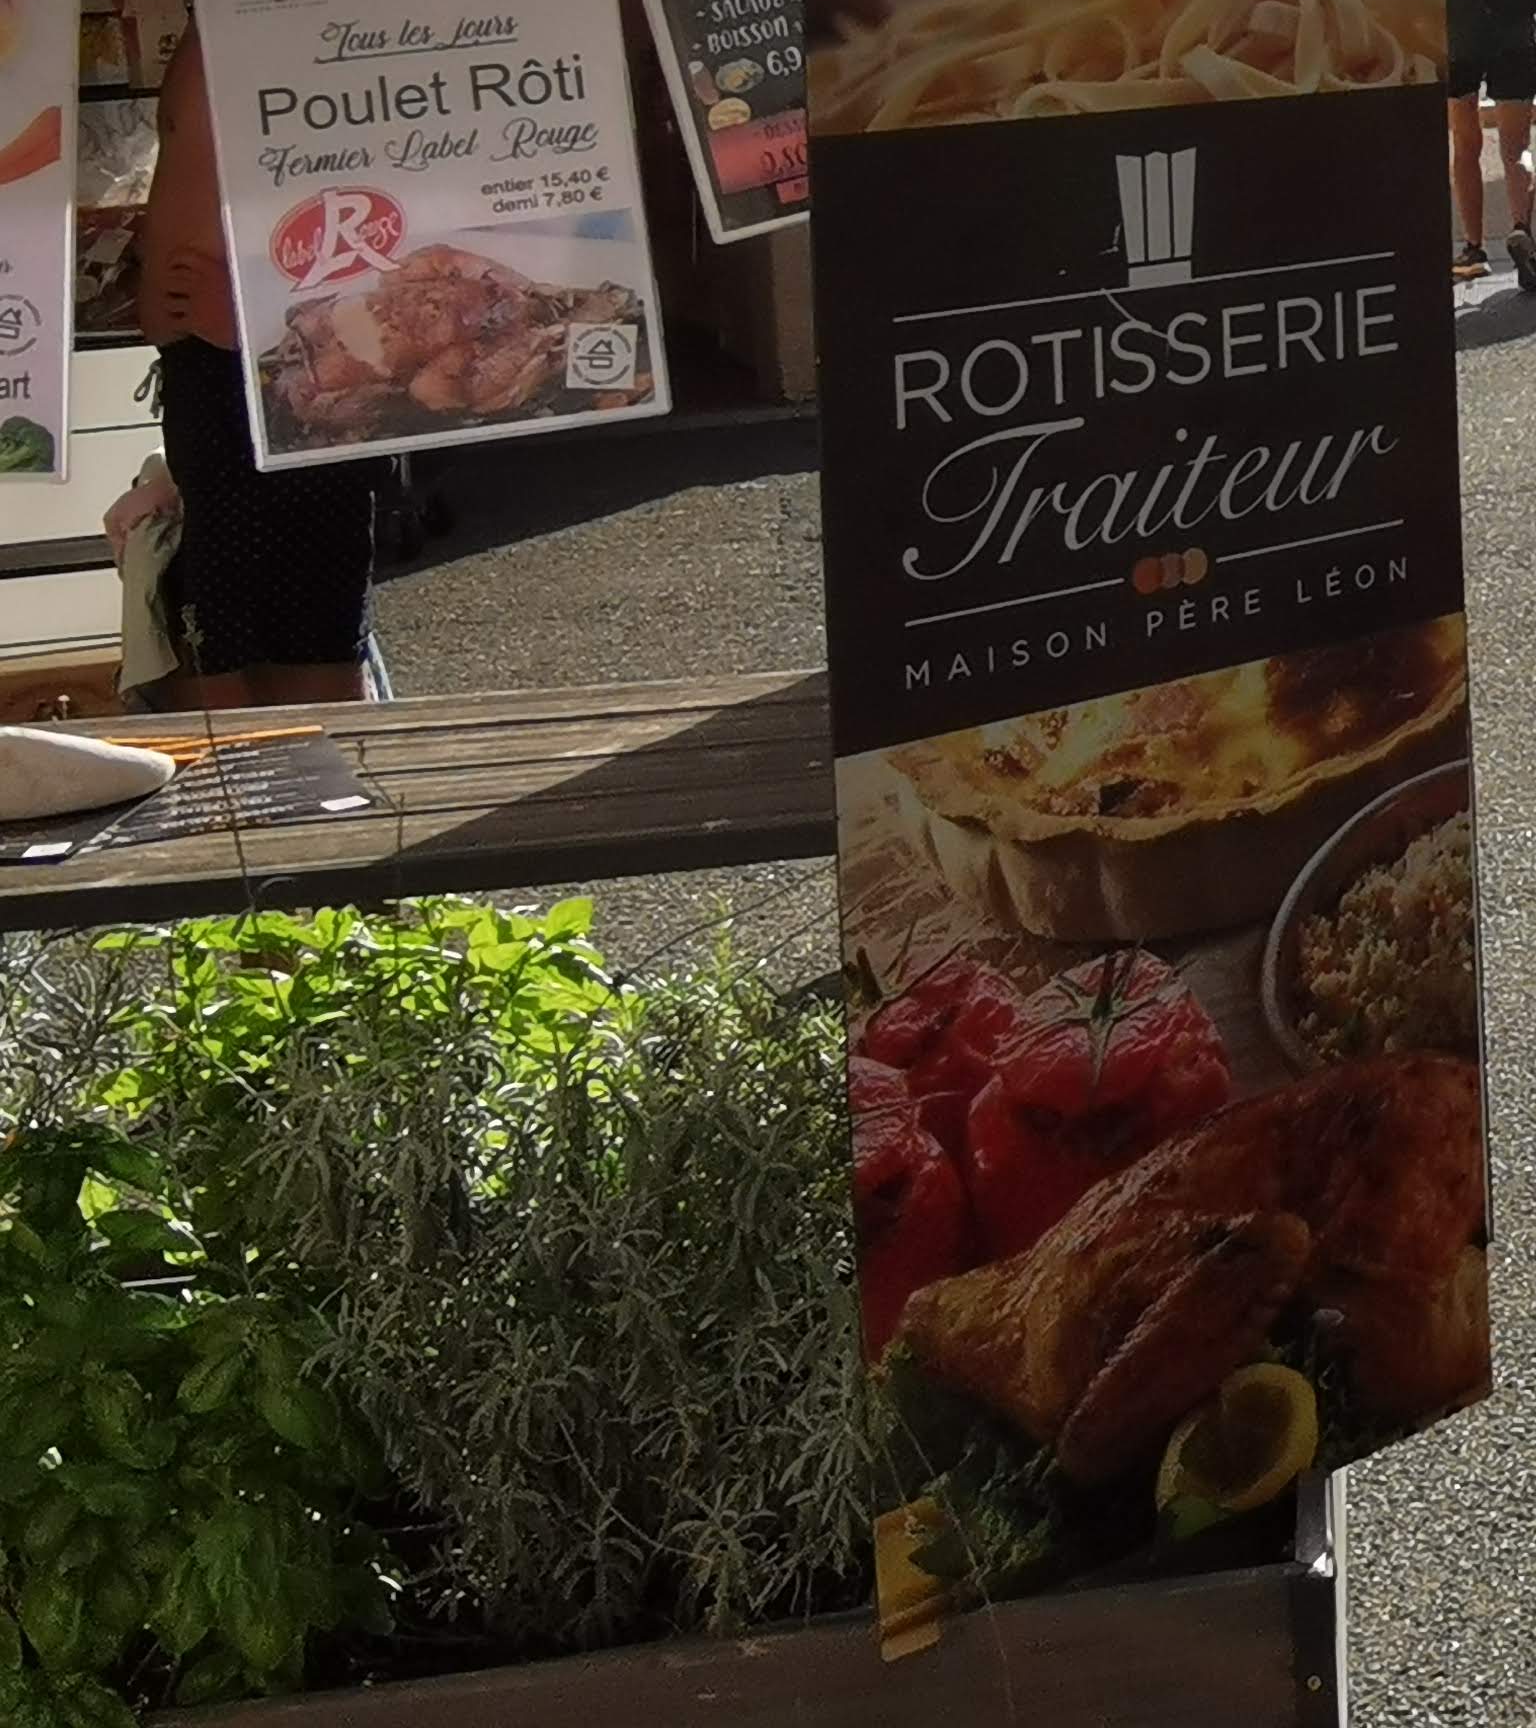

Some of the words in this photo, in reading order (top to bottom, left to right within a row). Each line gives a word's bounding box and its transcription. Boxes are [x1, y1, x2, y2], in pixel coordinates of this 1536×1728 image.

[321, 21, 391, 58] Tous
[397, 17, 435, 46] les
[434, 13, 519, 51] jours
[707, 16, 789, 56] BOISSON
[258, 71, 453, 137] Poulet
[469, 53, 586, 112] Rôti
[258, 143, 376, 188] Fermier
[384, 128, 480, 173] Label
[490, 117, 600, 164] Rouge
[480, 176, 536, 198] entier
[540, 169, 593, 191] 15,40
[595, 165, 611, 183] €
[491, 191, 540, 215] demi
[541, 187, 587, 210] 7,80
[589, 184, 605, 203] €
[895, 284, 1400, 432] ROTISSERIE
[902, 417, 1401, 583] Traiteur
[905, 620, 1108, 690] MAISON
[1145, 587, 1264, 639] PÈRE
[1296, 555, 1412, 603] LÉON
